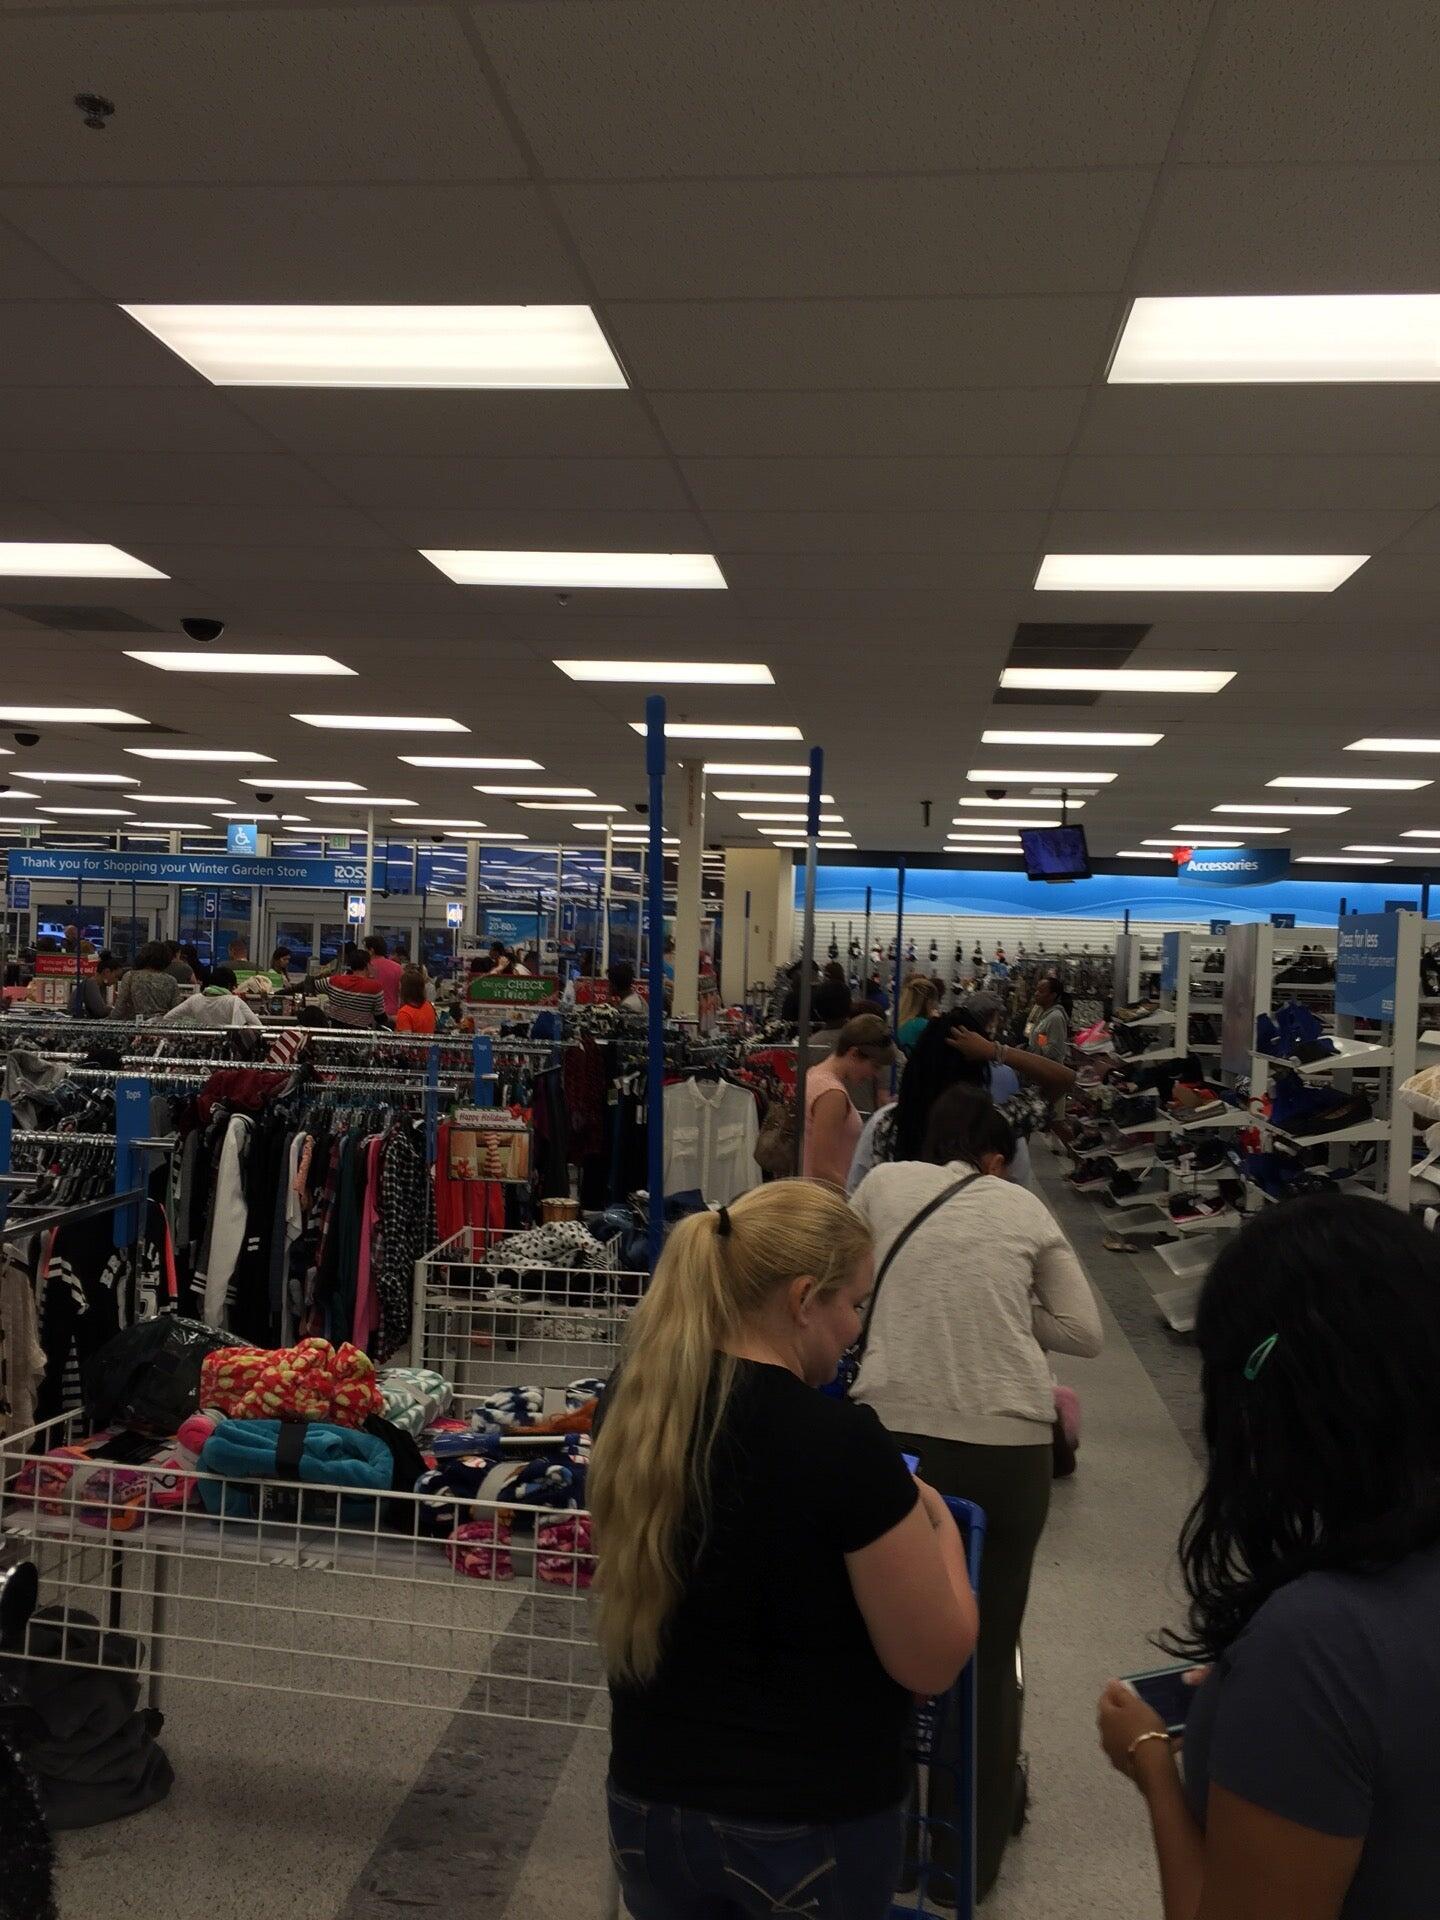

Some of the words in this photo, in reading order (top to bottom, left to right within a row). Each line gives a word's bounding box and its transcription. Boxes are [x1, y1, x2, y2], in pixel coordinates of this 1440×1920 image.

[21, 856, 56, 869] Thank
[59, 860, 81, 871] you
[84, 858, 100, 869] for
[103, 859, 157, 875] Shopping
[160, 862, 187, 875] your
[189, 862, 228, 875] Winter
[231, 864, 274, 877] Garden
[277, 866, 308, 877] Store
[1186, 859, 1258, 872] Accessories
[206, 899, 215, 913] 5
[565, 911, 572, 925] 1
[1277, 919, 1287, 928] 7
[1215, 924, 1224, 935] 6
[1338, 931, 1353, 948] Dress
[1354, 929, 1364, 948] for
[1365, 928, 1379, 948] less
[507, 980, 545, 990] CHECK
[125, 1090, 142, 1101] Tops
[459, 1113, 479, 1122] Happy
